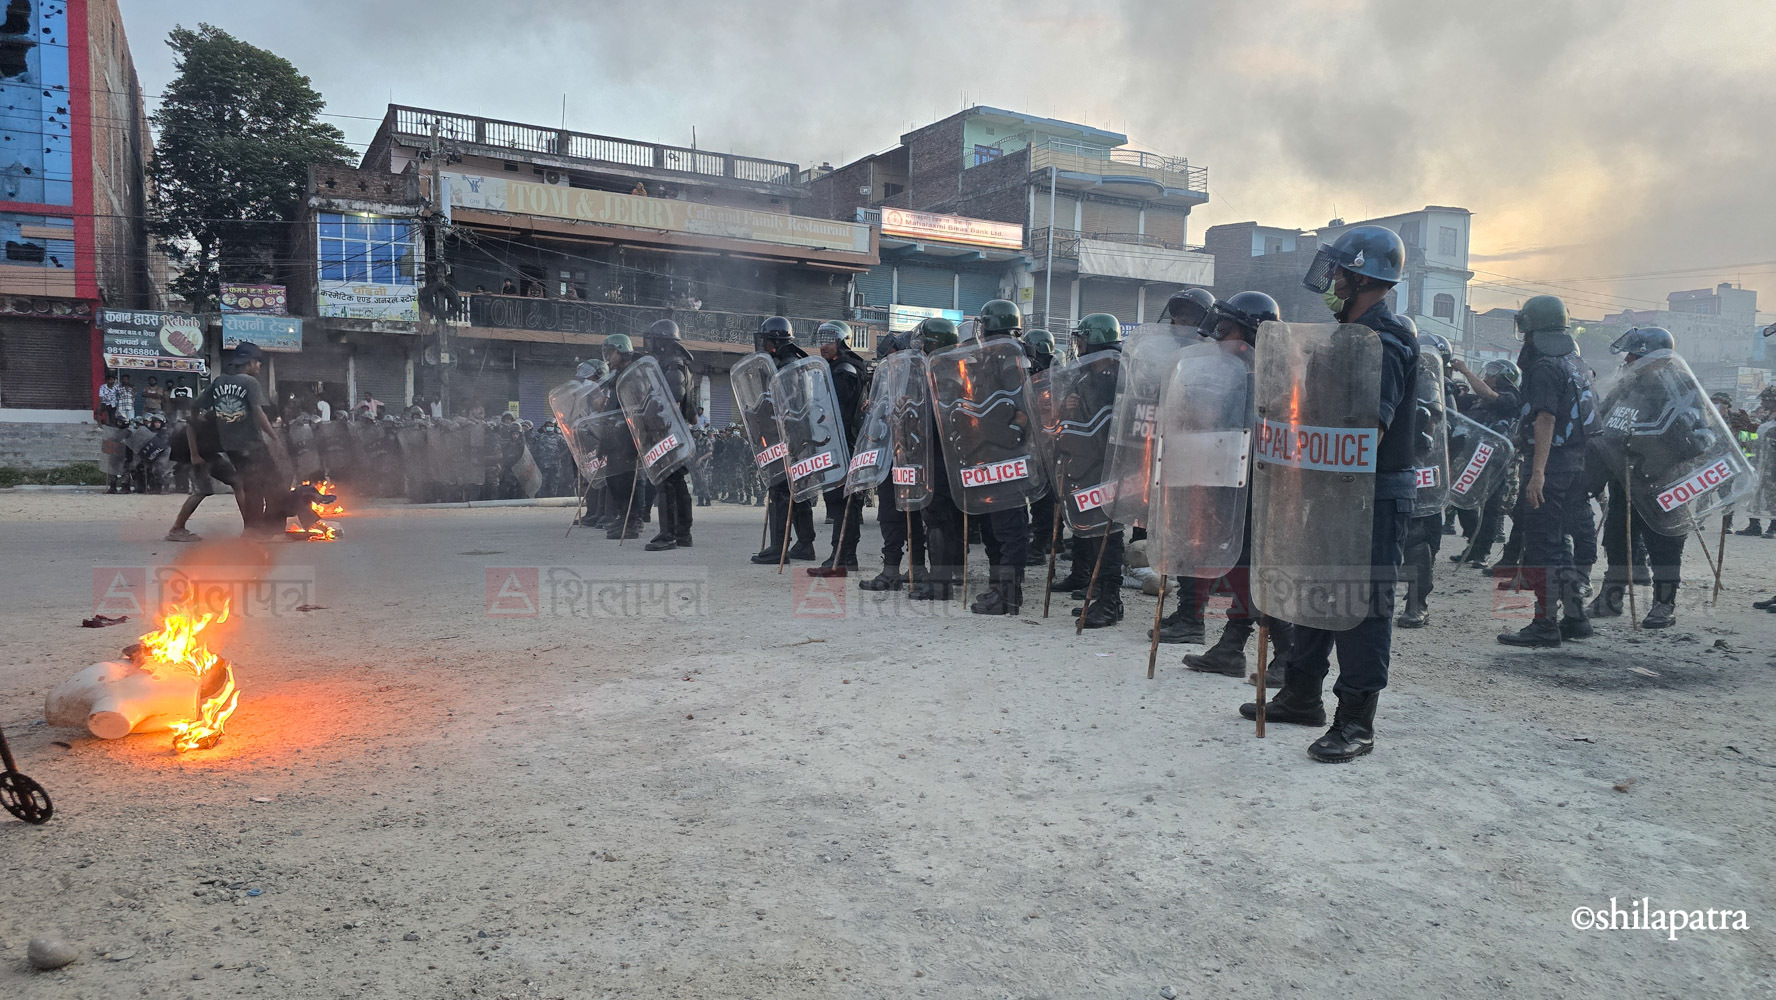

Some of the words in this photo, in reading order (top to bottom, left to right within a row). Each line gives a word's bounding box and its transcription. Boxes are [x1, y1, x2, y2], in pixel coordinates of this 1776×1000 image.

[512, 184, 570, 216] TOM
[575, 190, 595, 219] &
[600, 193, 680, 228] JERRY
[686, 203, 715, 220] Cafe
[721, 210, 740, 223] and
[744, 212, 784, 231] Family
[788, 217, 850, 238] Restaurant
[905, 219, 946, 230] Mahalaxmi
[947, 224, 969, 233] Bikas
[970, 227, 988, 236] Bank
[990, 229, 1004, 237] Ltd.
[134, 313, 159, 326] हाउस
[160, 315, 200, 328] Kebab
[225, 317, 265, 331] रोशनी
[474, 298, 522, 328] TOM
[526, 303, 543, 329] &
[544, 303, 622, 334] JERRY
[107, 347, 159, 356] 9814368804
[1605, 417, 1630, 431] POLIC
[646, 435, 677, 465] POLICE
[758, 444, 788, 465] POLICE
[1255, 422, 1292, 461] NEPAL
[1298, 430, 1370, 467] POLICE
[791, 454, 831, 480] POLICE
[962, 461, 1027, 485] POLICE
[1455, 445, 1492, 492] POLICE
[1659, 462, 1731, 510] POLICE
